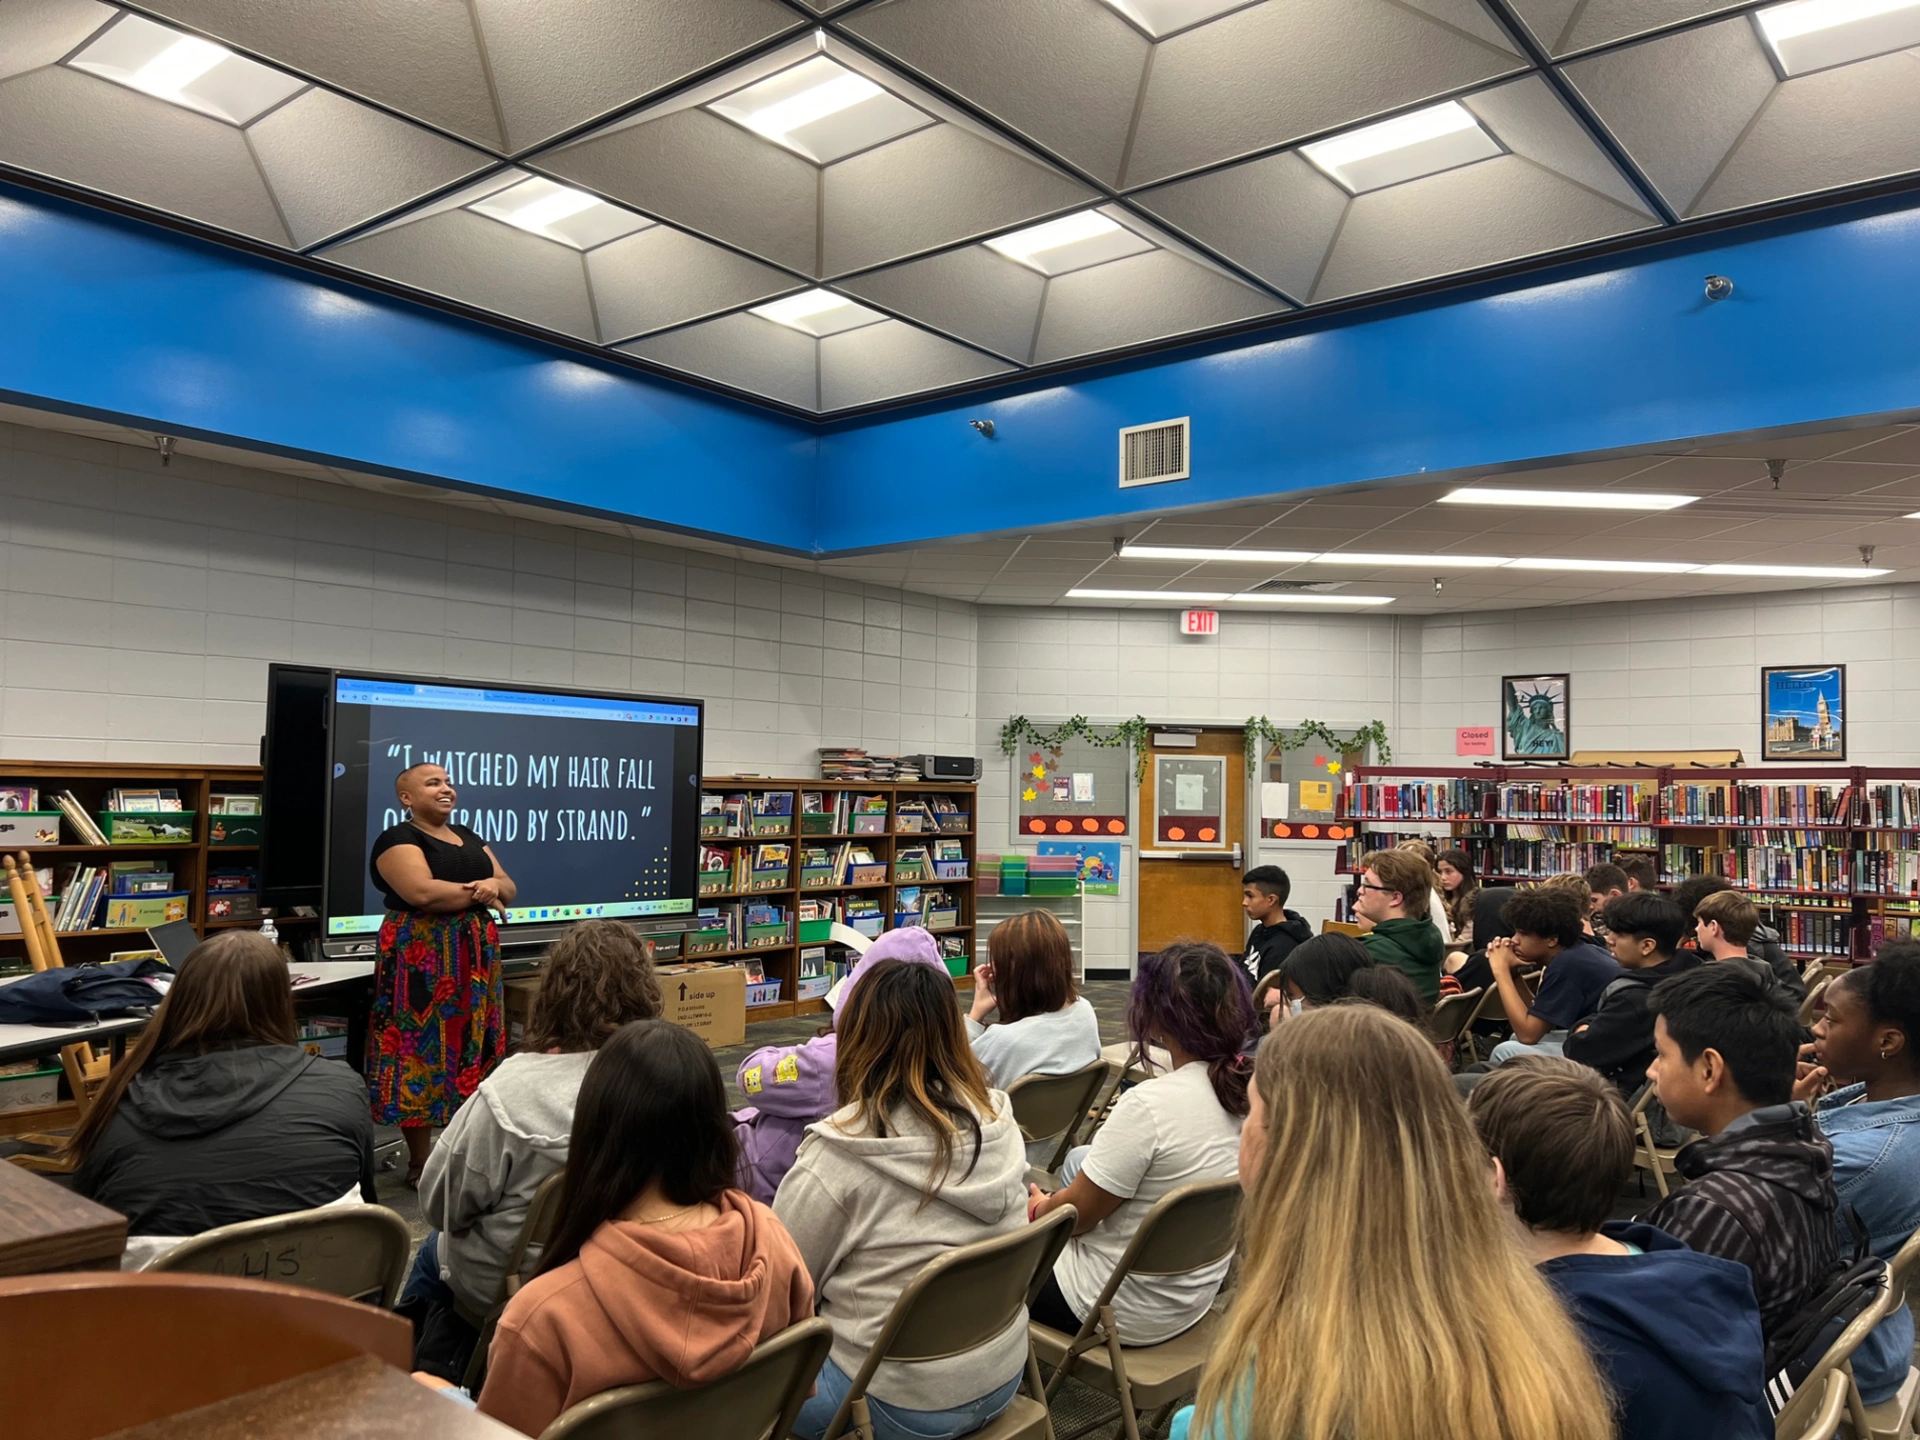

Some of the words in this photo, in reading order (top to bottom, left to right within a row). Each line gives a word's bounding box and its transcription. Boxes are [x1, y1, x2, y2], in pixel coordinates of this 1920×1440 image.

[1188, 612, 1215, 632] EXIT
[1776, 681, 1813, 690] HELLO
[1461, 731, 1489, 739] Closed
[527, 754, 560, 789] MY
[568, 756, 610, 789] HAIR
[617, 758, 656, 790] FALL
[527, 809, 549, 842] BY
[689, 992, 704, 1000] side
[705, 991, 716, 999] up
